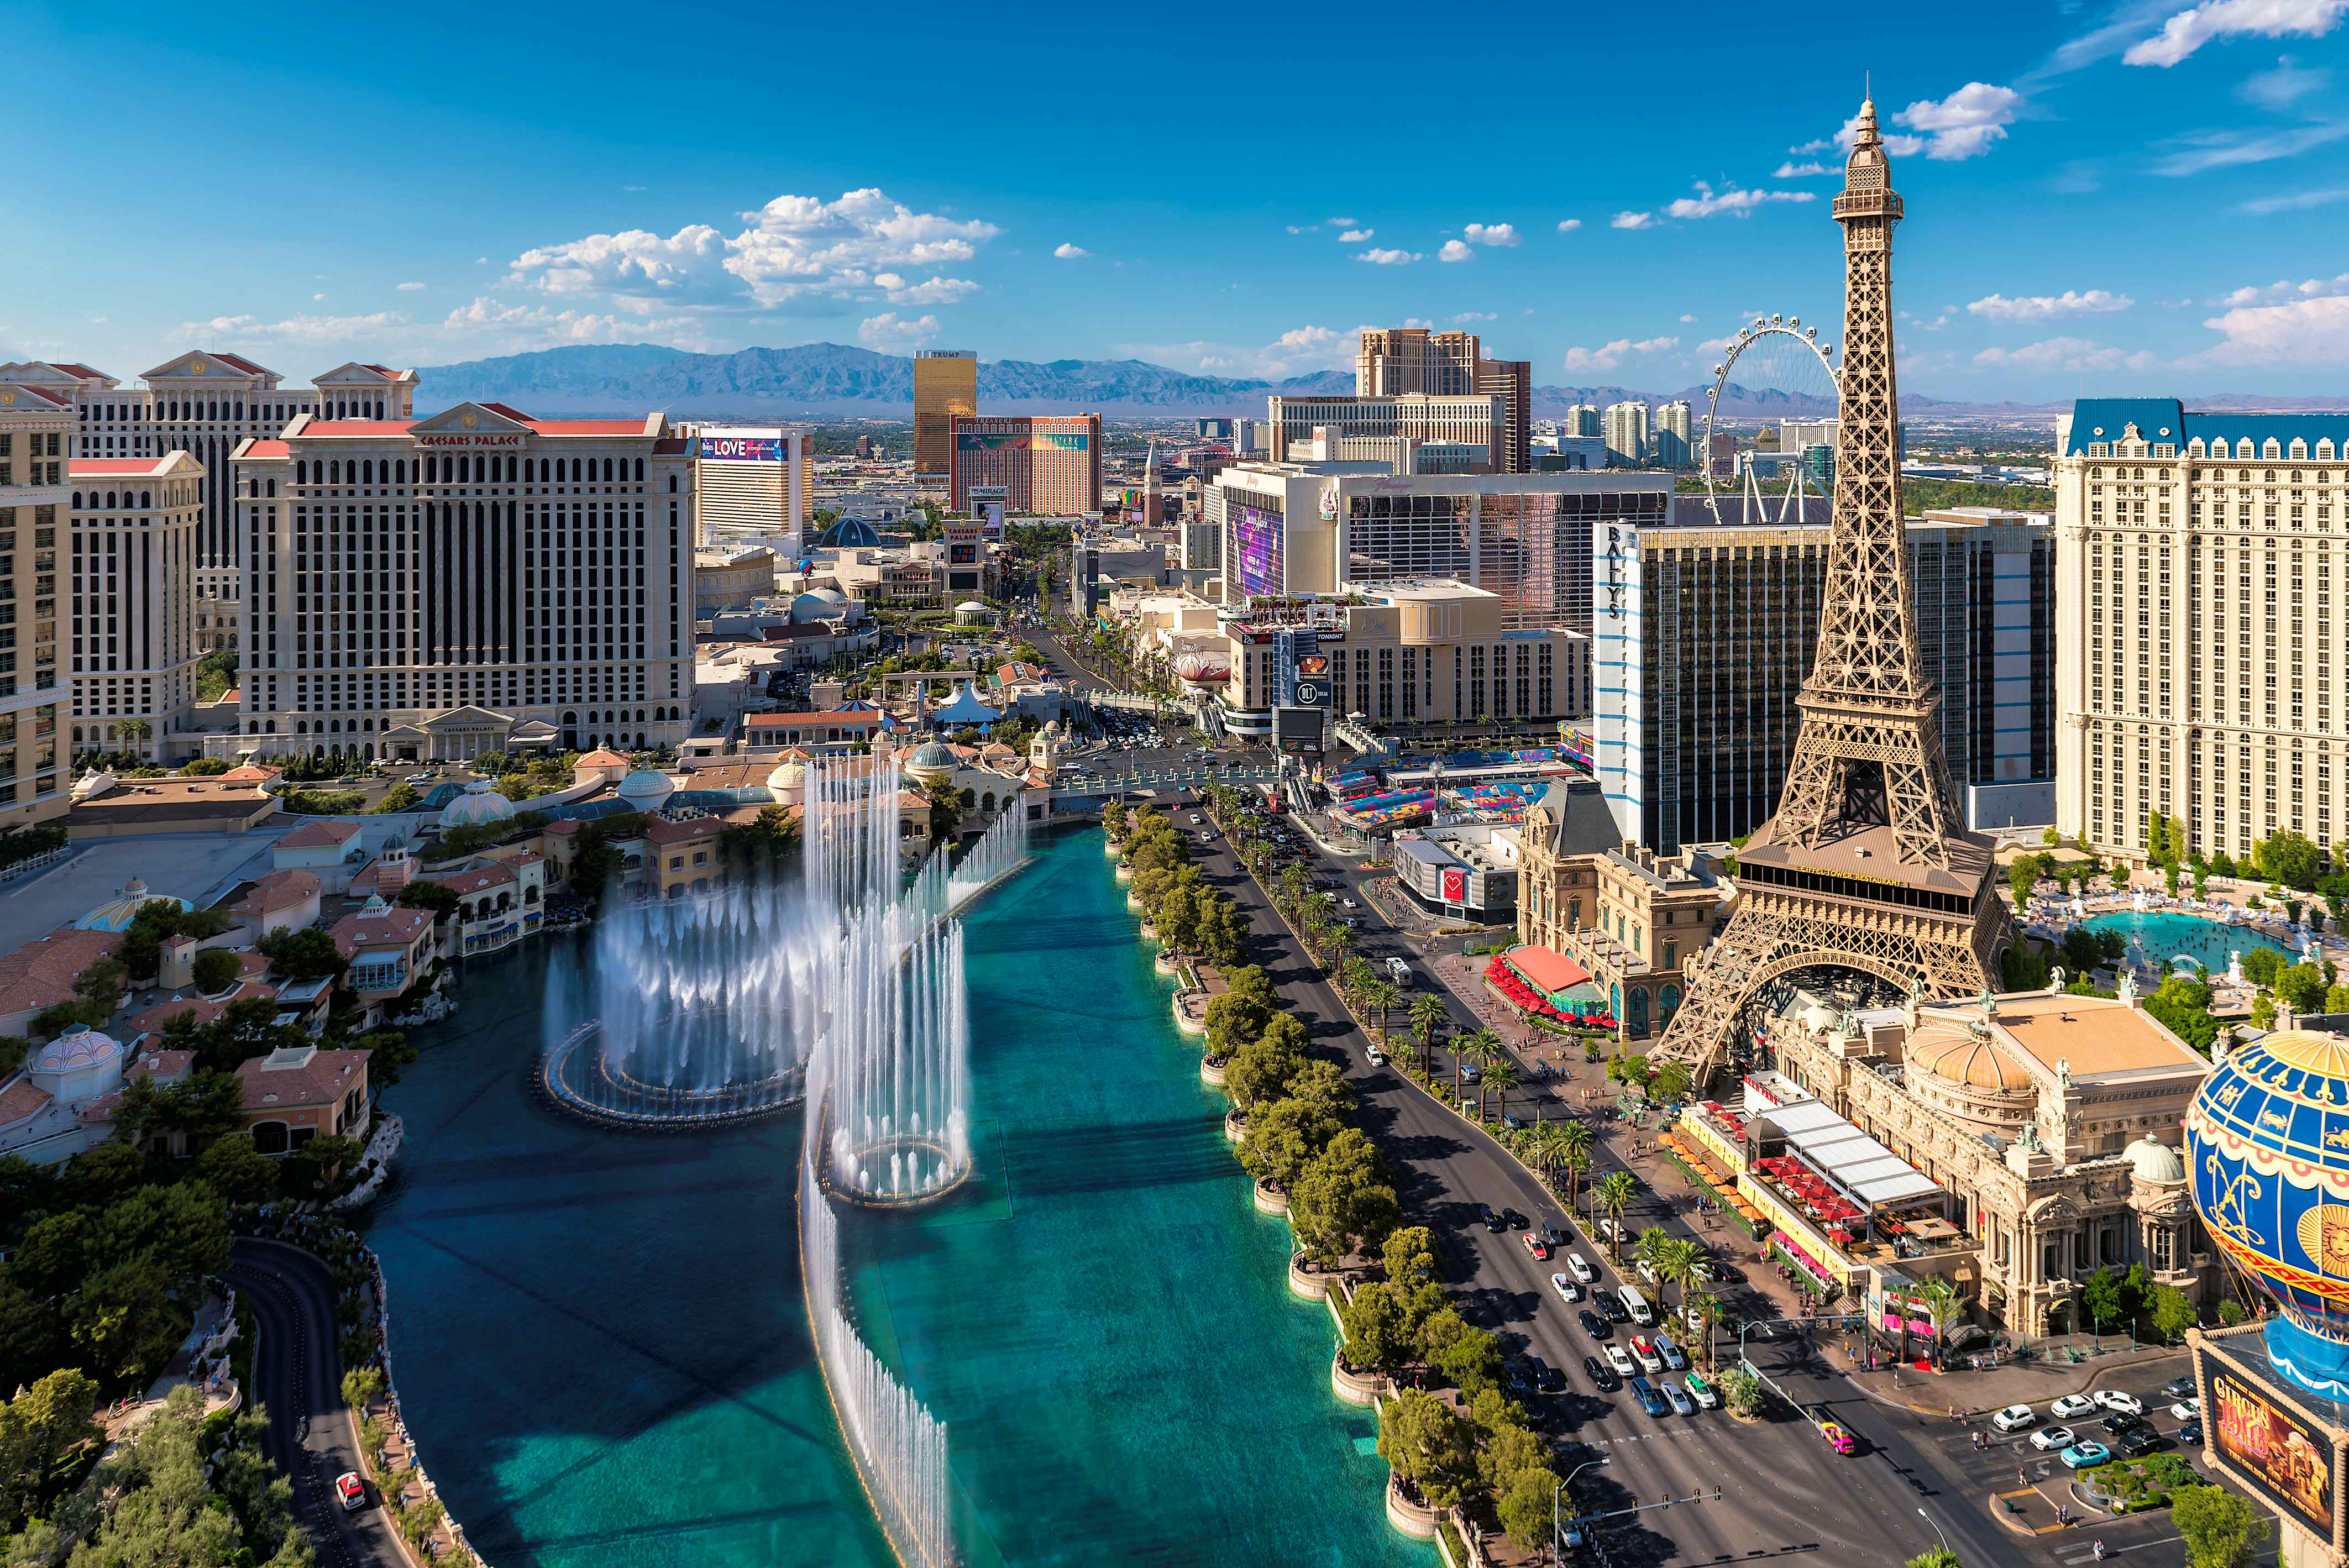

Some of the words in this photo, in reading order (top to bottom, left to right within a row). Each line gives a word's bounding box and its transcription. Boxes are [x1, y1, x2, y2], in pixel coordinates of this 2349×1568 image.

[420, 436, 470, 445] CAESARS
[475, 436, 519, 445] PALACE
[715, 440, 746, 456] LOVE
[1607, 527, 1622, 619] BALLYS
[1302, 688, 1313, 699] BLT
[1395, 846, 1423, 888] CVS
[1743, 1074, 1761, 1092] BEER
[1761, 1087, 1778, 1106] PARK
[2214, 1376, 2270, 1430] CIRCUS
[2225, 1374, 2235, 1386] THE
[2235, 1380, 2248, 1395] MOST
[2248, 1390, 2270, 1410] AMAZING
[2270, 1406, 2284, 1420] SHOW
[2284, 1415, 2291, 1425] ON
[2291, 1420, 2309, 1438] EARTH
[2221, 1399, 2269, 1456] 1903
[2227, 1448, 2241, 1464] THE
[2241, 1458, 2267, 1483] GOLDEN
[2268, 1478, 2282, 1493] AGE
[2281, 1488, 2291, 1500] OF
